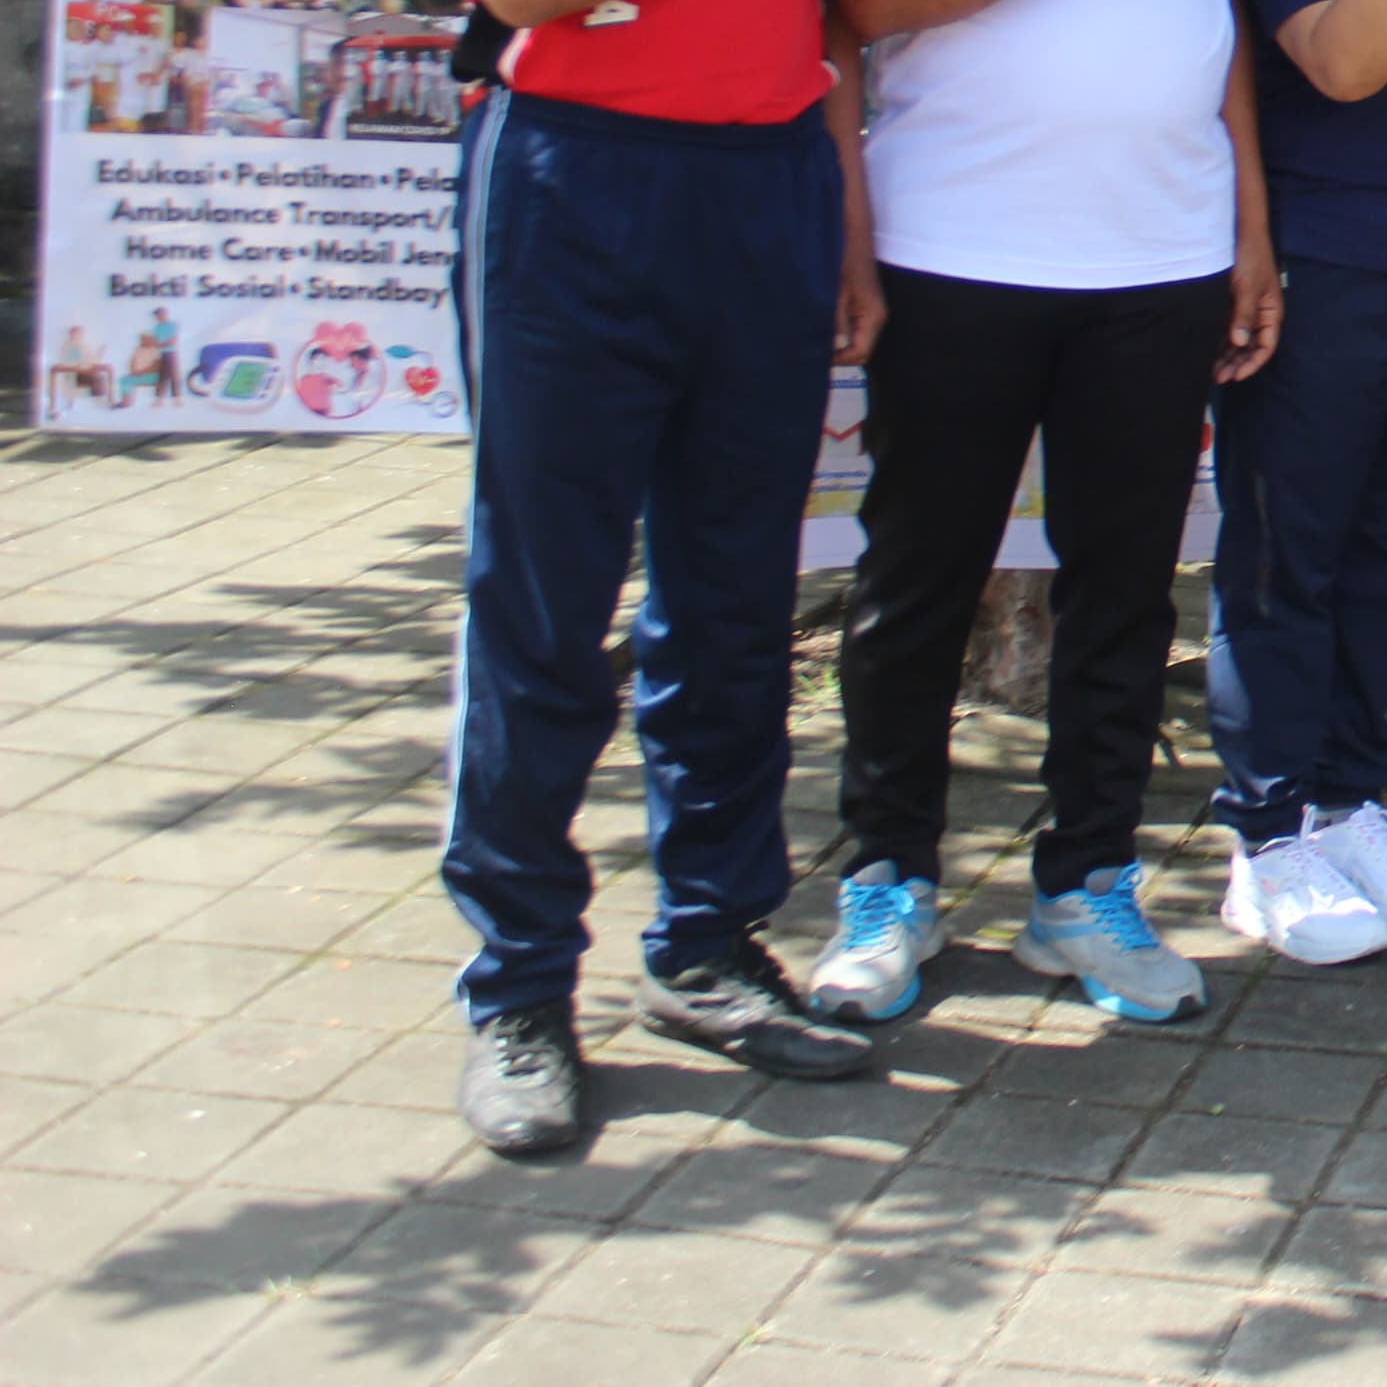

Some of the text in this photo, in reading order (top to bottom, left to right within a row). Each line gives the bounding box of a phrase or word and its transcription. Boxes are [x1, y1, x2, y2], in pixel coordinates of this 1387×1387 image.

[97, 159, 216, 185] Edukasi
[236, 163, 375, 189] Pelatihan
[110, 197, 282, 224] Ambulance
[125, 235, 212, 260] Home
[222, 236, 295, 262] Care
[314, 238, 396, 264] Mobil
[109, 272, 450, 311] Bakti Sosial Standbay
